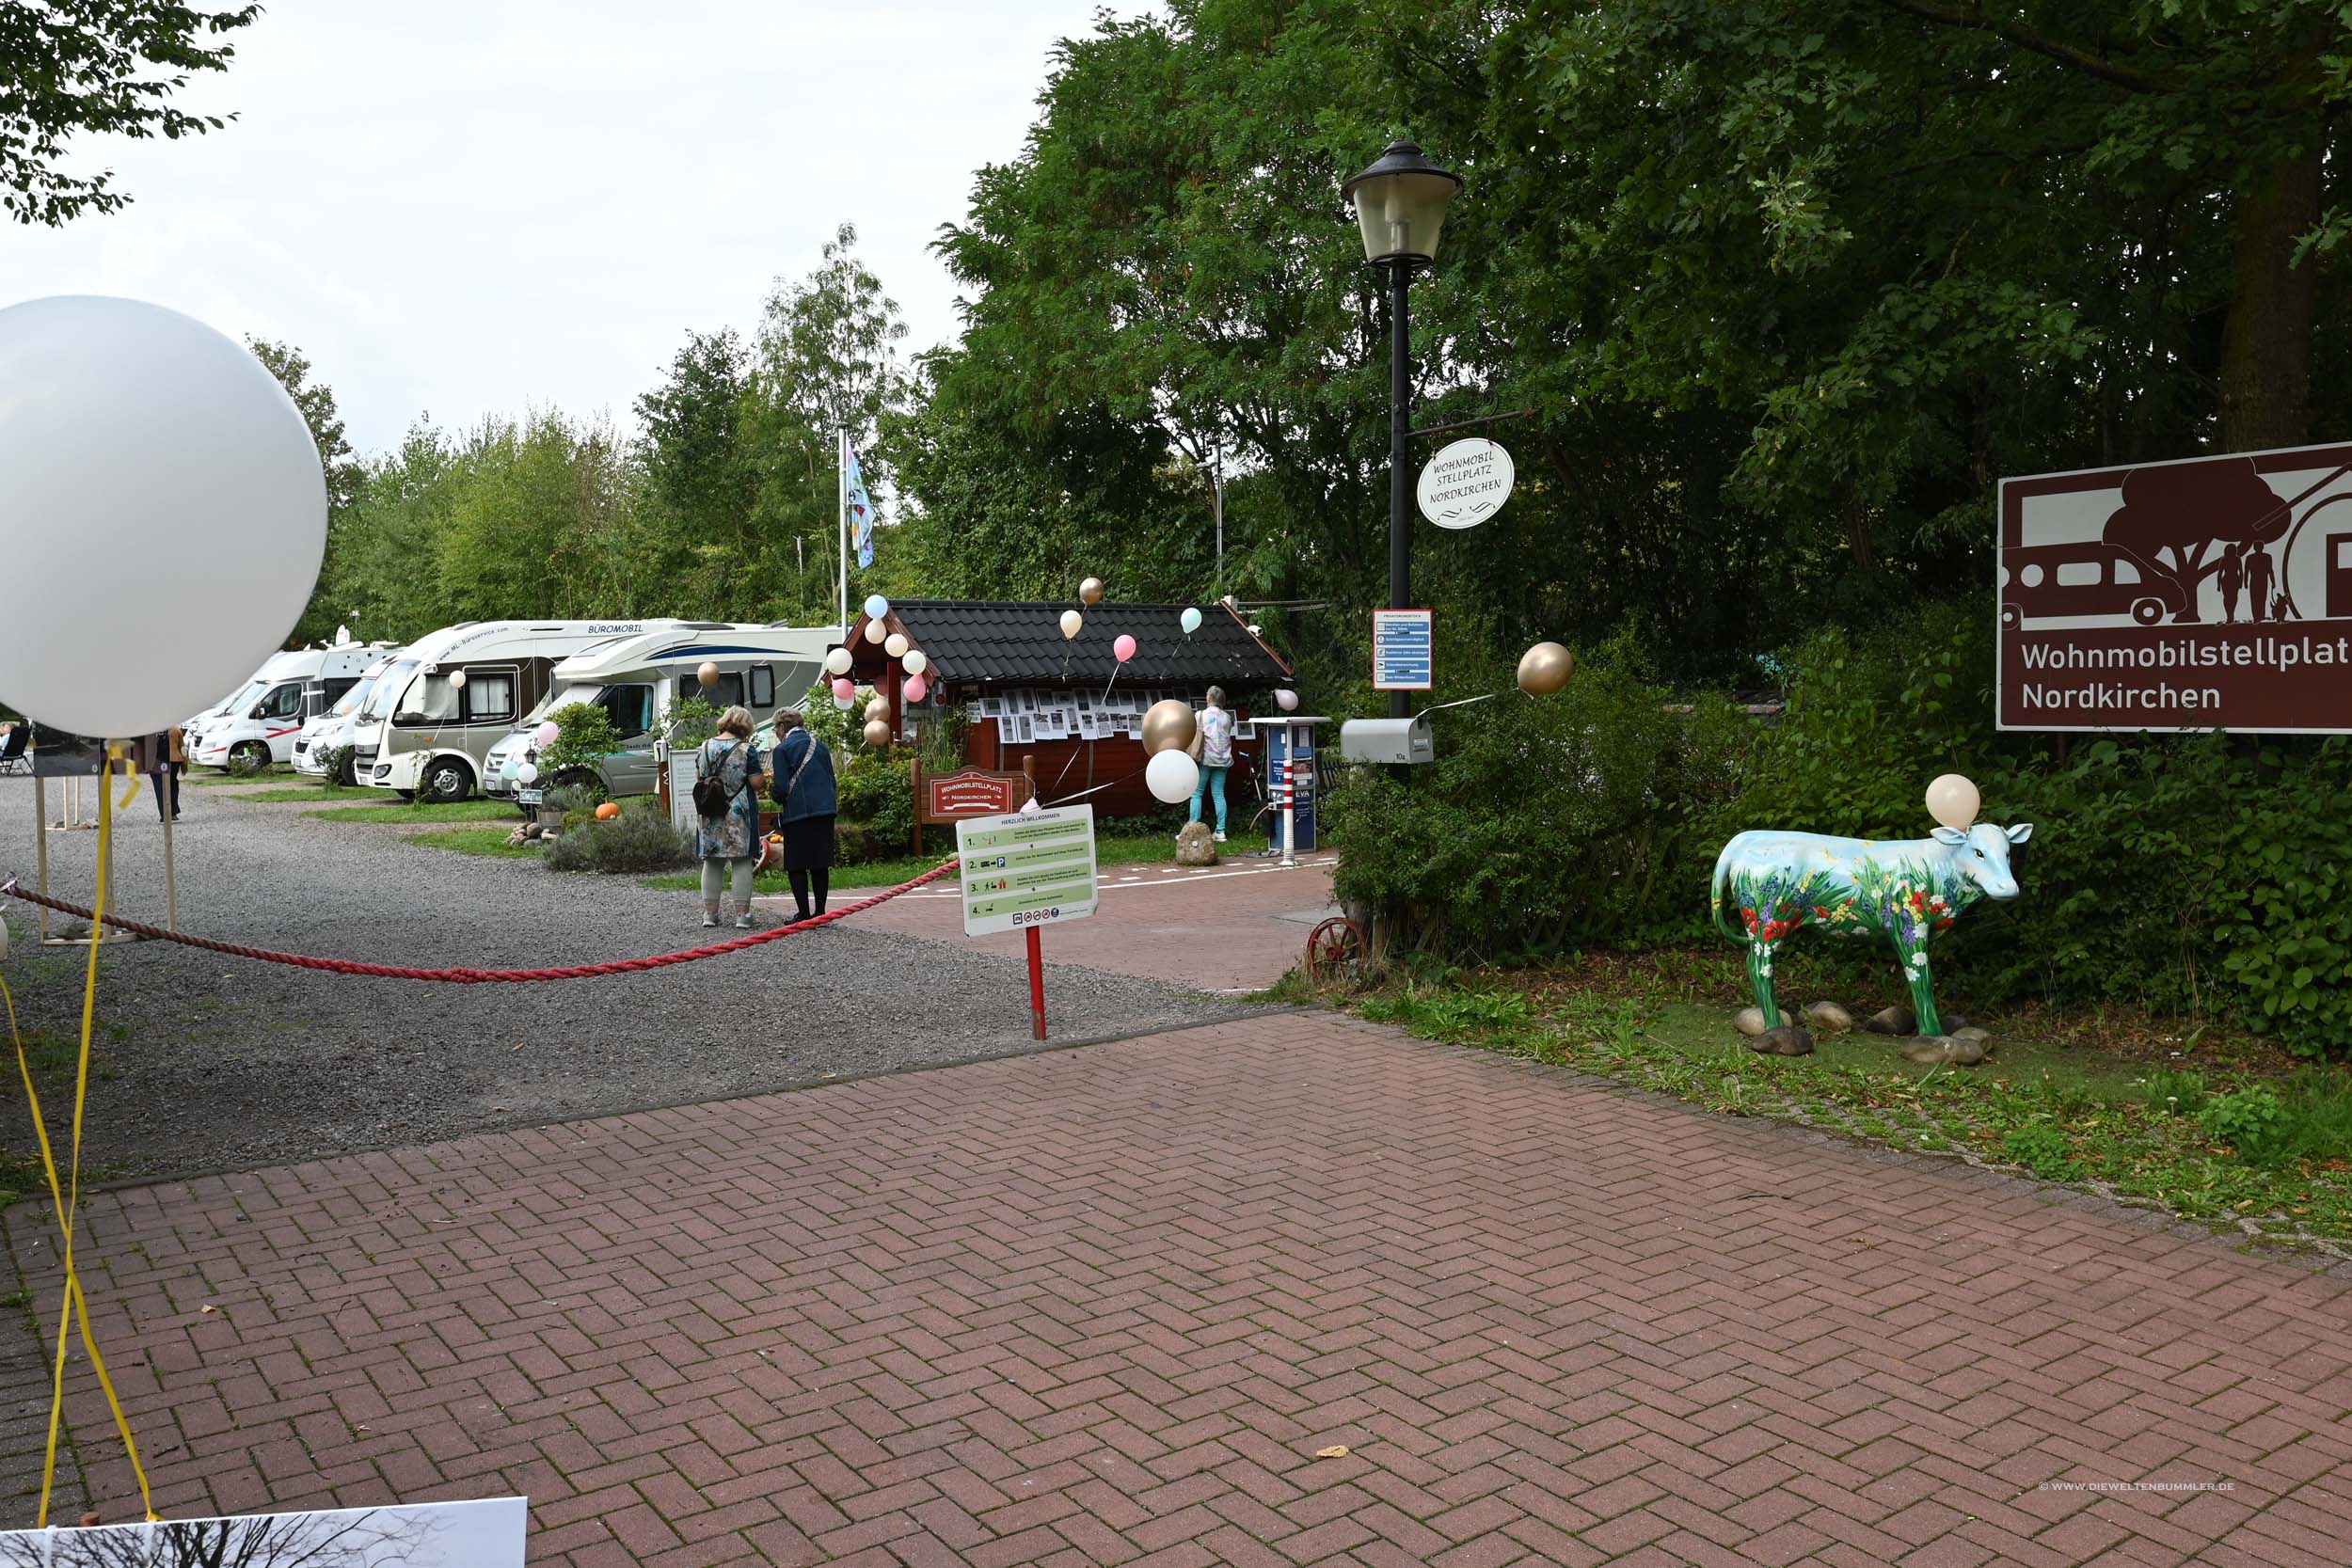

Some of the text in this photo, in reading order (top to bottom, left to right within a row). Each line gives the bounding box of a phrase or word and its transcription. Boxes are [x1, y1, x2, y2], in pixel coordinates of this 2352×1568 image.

[1433, 451, 1494, 474] WOHNMOBIL
[1437, 464, 1492, 486] STELLPLATZ
[1429, 478, 1502, 504] NORDKIRCHEN
[588, 624, 644, 634] BÜROMOBIL
[2022, 636, 2349, 673] Wohnmobilstellplat
[2022, 682, 2221, 709] Nordkirchen
[941, 782, 1002, 794] WOHNMOBILSTELLPLATZ
[1295, 789, 1310, 798] EVA
[1001, 812, 1060, 826] HERZLICH WILLKOMMEN
[967, 838, 976, 847] 1.
[969, 861, 977, 869] 2.
[971, 883, 978, 893] 3.
